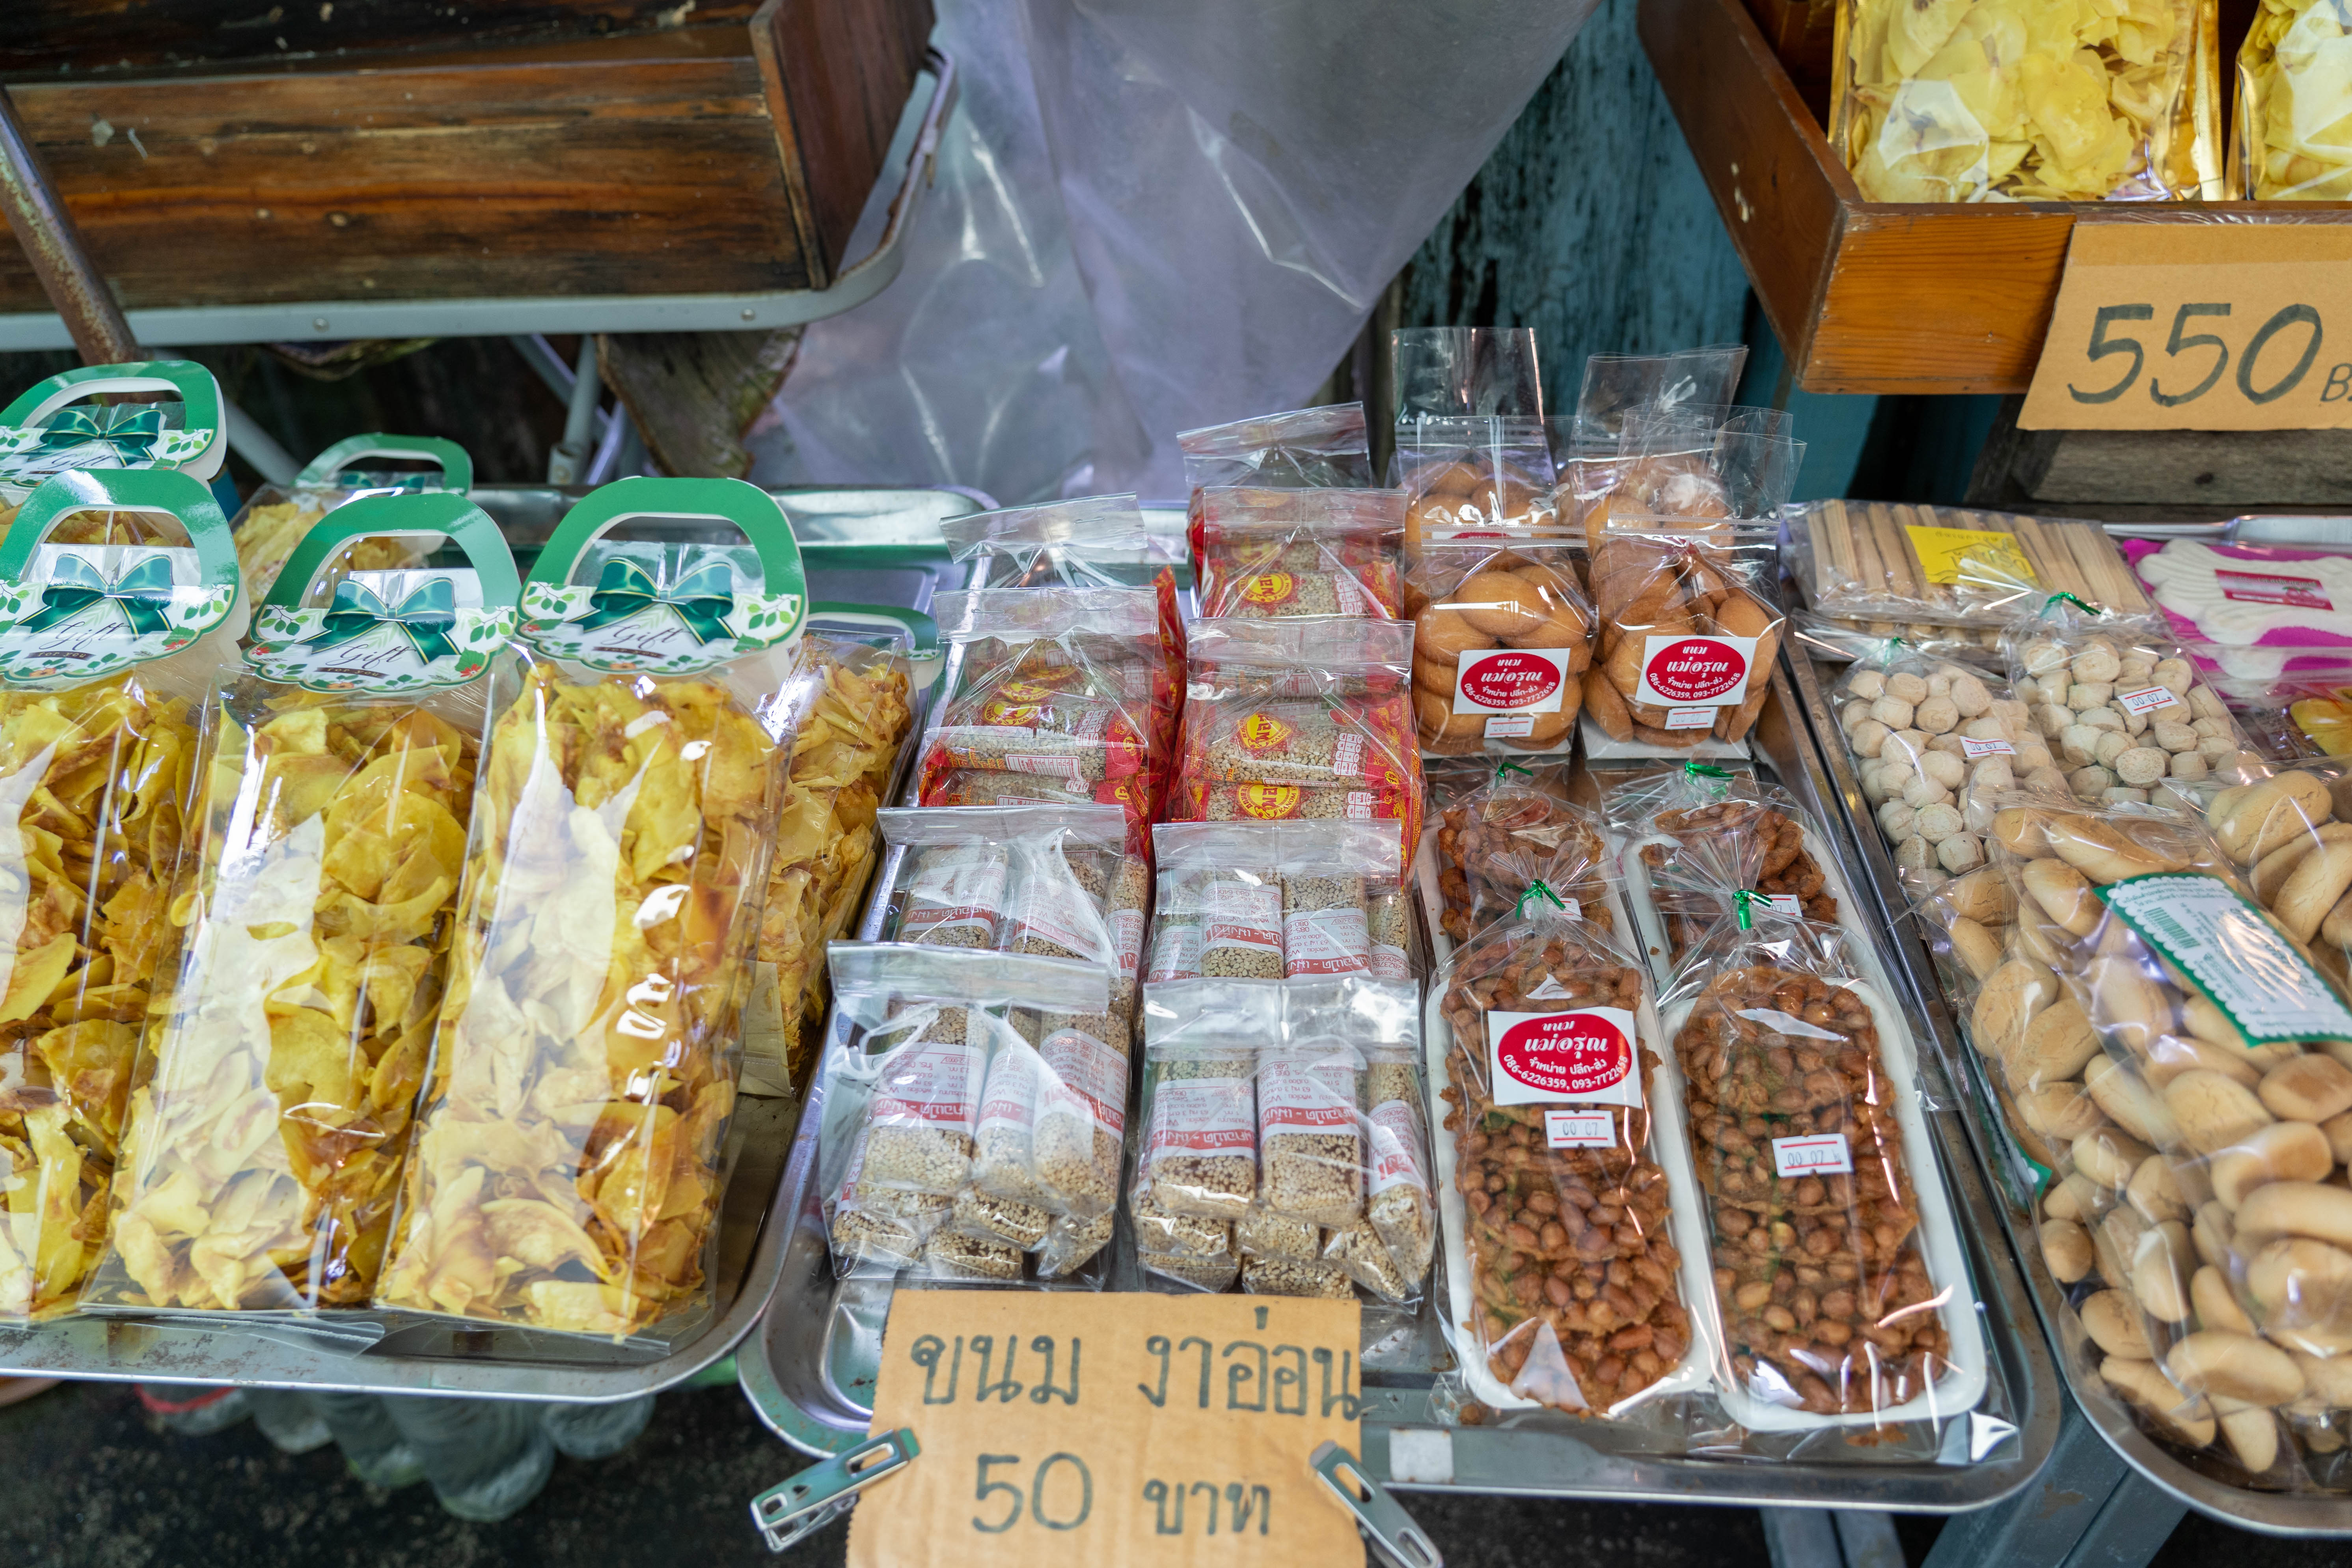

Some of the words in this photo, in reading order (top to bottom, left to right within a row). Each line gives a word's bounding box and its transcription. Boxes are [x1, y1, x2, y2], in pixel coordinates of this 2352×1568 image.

[2067, 303, 2323, 406] 550
[39, 621, 130, 651] Gift
[600, 625, 691, 649] Gift
[325, 644, 417, 669] Gift
[1682, 646, 1707, 654] ขนม
[1481, 668, 1543, 686] แม่อรุณ
[1666, 656, 1729, 678] แม่อรุณ
[1482, 686, 1507, 697] จำหน่าย
[1510, 682, 1556, 706] 093-7722658
[1668, 676, 1692, 689] จำหน่าย
[1693, 672, 1741, 697] 093-7722658
[1278, 793, 1297, 814] KANOM
[1542, 1020, 1576, 1031] ขนม
[1525, 1032, 1608, 1059] แม่อรุณ
[1529, 1057, 1566, 1074] จำหน่าย
[1572, 1055, 1629, 1089] 093-7722658
[911, 1333, 1081, 1406] ขนม
[1138, 1306, 1371, 1421] งาอ่อน
[971, 1452, 1093, 1534] 50
[1142, 1477, 1271, 1536] บาท
